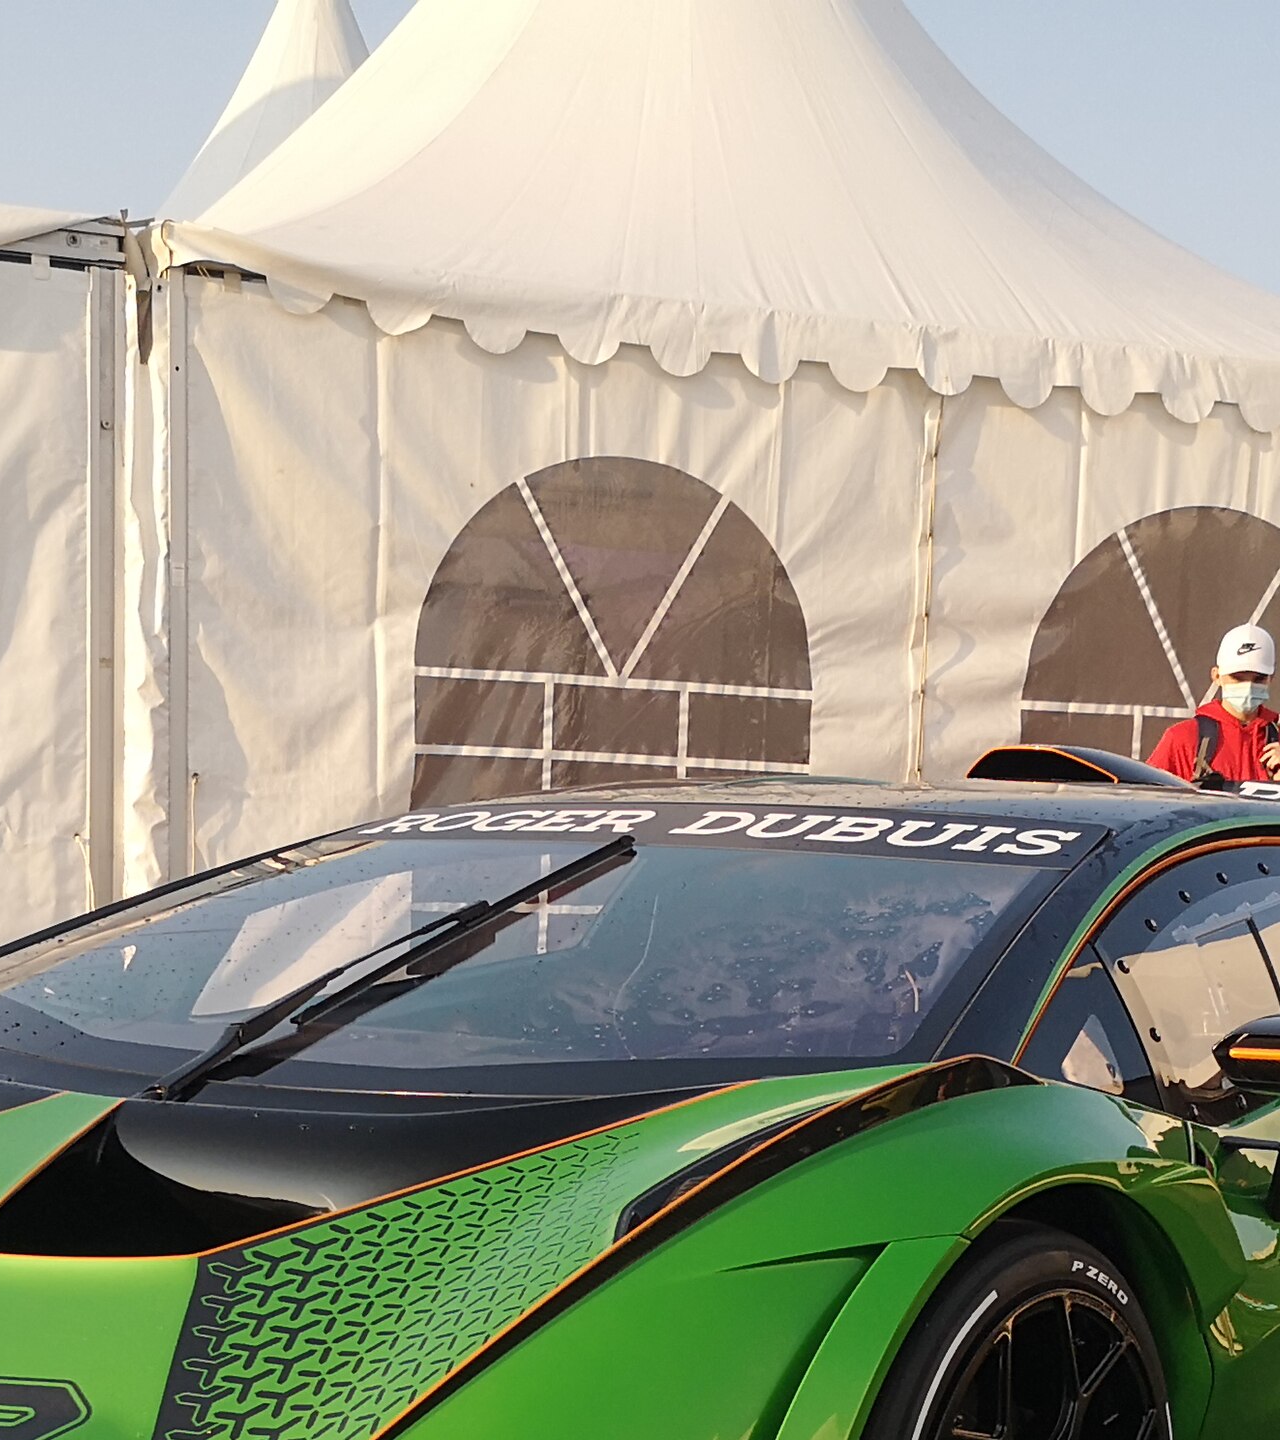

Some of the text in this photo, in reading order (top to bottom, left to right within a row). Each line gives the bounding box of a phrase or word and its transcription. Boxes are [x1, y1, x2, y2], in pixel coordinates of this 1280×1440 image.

[357, 809, 1082, 857] ROGER DUBUIS
[1071, 1260, 1129, 1305] P ZERO
